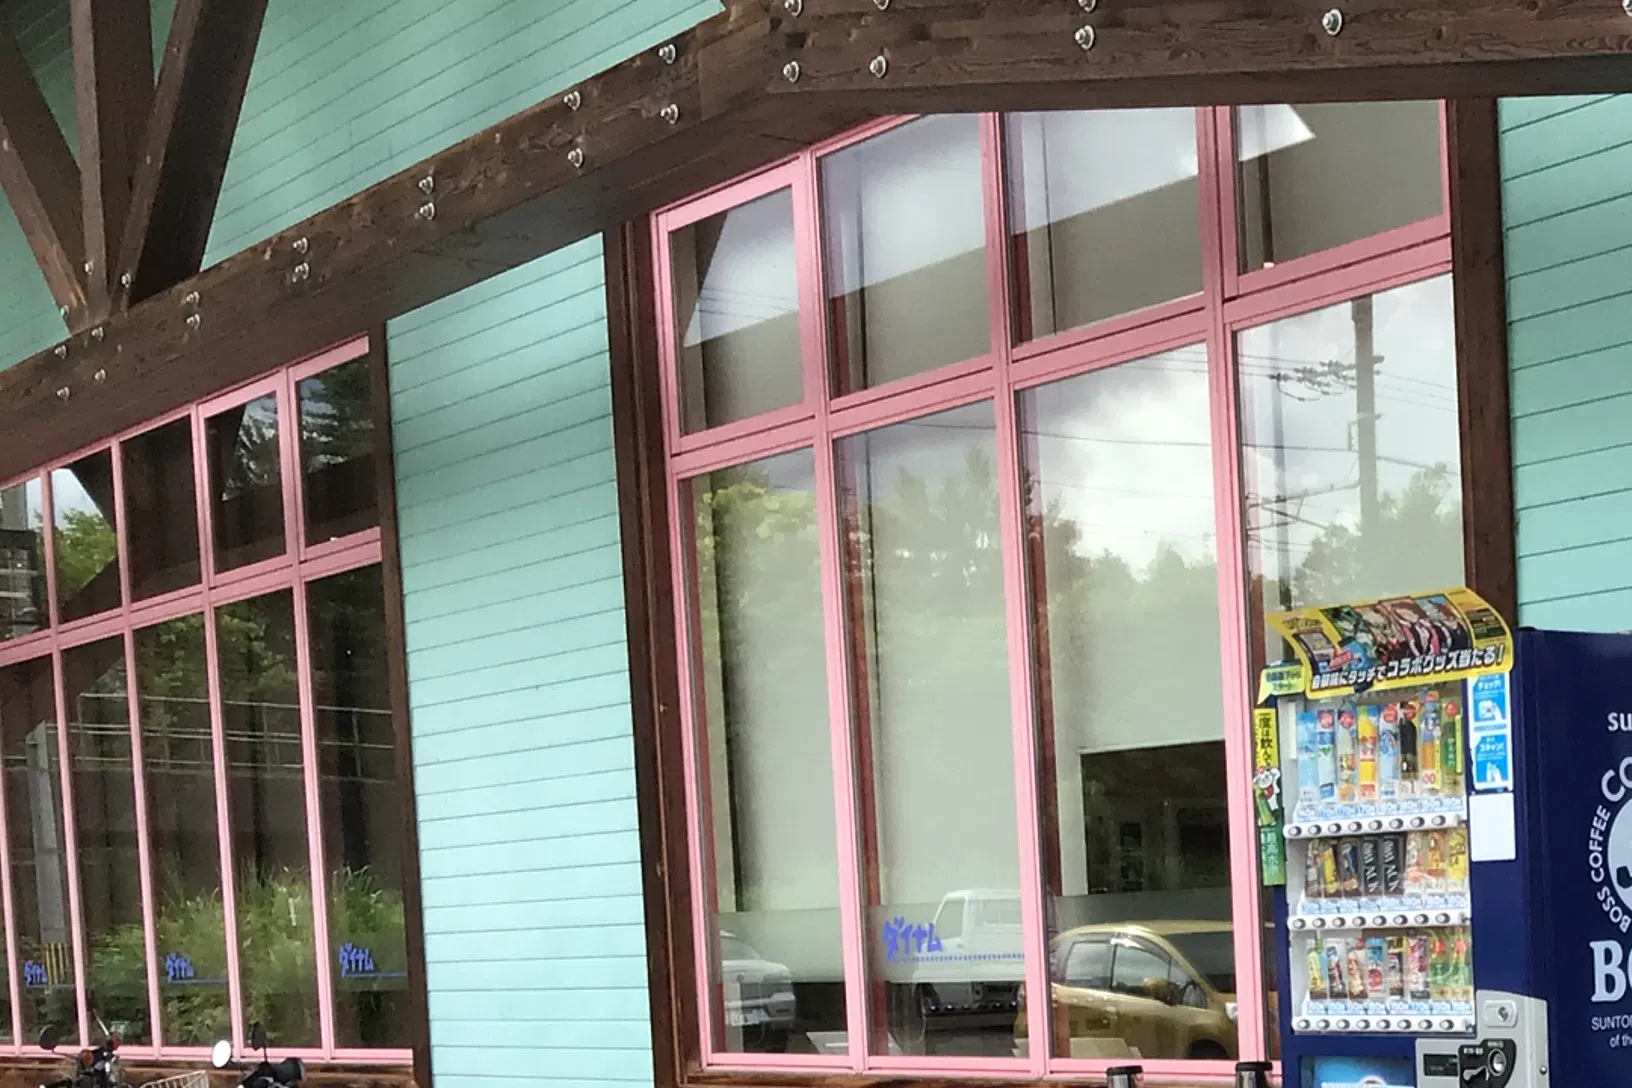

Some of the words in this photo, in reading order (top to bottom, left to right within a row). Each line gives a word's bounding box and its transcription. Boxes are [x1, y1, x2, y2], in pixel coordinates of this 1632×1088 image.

[1589, 804, 1611, 883] COFFEE
[1597, 886, 1632, 933] BOSS
[882, 916, 943, 963] ダイナム
[1610, 1033, 1618, 1048] of
